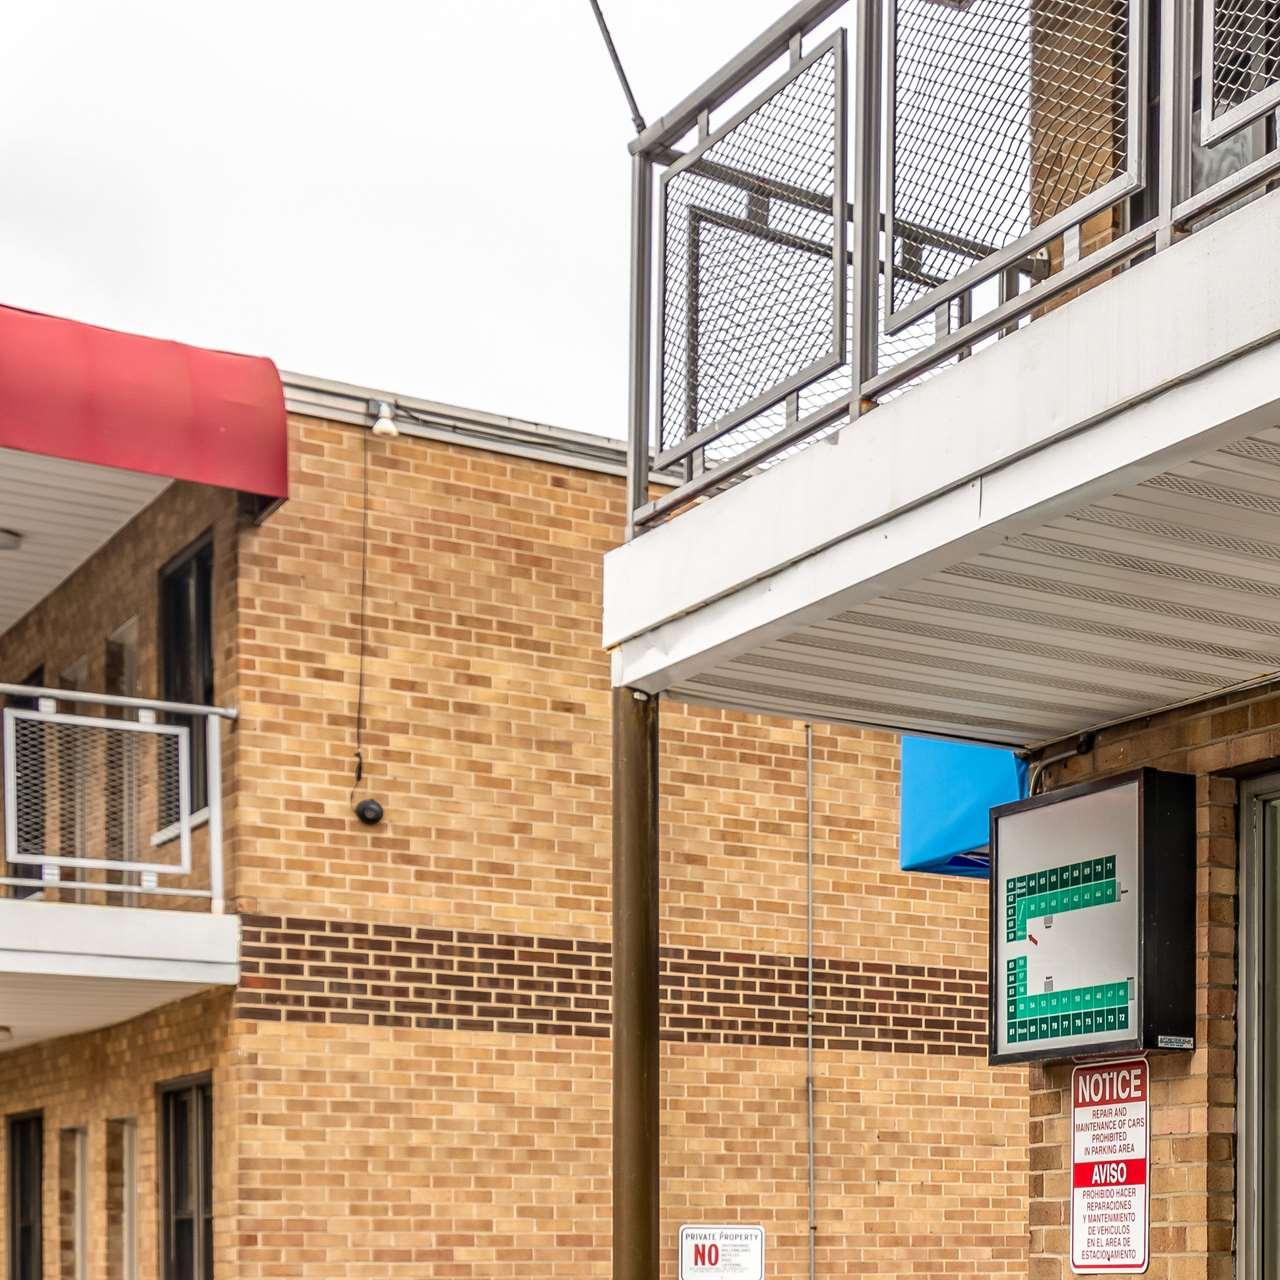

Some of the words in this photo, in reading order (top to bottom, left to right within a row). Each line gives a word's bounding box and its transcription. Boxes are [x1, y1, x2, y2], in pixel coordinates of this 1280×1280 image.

[1078, 1069, 1142, 1103] NOTICE
[1092, 1108, 1113, 1119] REPAIR
[1114, 1107, 1127, 1117] AND
[1076, 1120, 1116, 1133] MAINTENANCE
[1118, 1120, 1125, 1129] OF
[1127, 1118, 1144, 1128] CARS
[1092, 1131, 1127, 1143] PROHIBITED
[1084, 1147, 1090, 1155] IN
[1091, 1144, 1117, 1155] PARKING
[1118, 1143, 1135, 1153] AREA
[1092, 1162, 1127, 1184] AVISO
[1082, 1189, 1114, 1199] PROHIBIDO
[1116, 1188, 1136, 1198] HACER
[1086, 1200, 1132, 1211] REPARACIONES
[1083, 1215, 1086, 1223] Y
[1088, 1213, 1136, 1223] MANTENIMIENTO
[1088, 1226, 1095, 1235] DE
[1097, 1225, 1130, 1235] VEHICULOS
[1087, 1238, 1094, 1247] EN
[1097, 1238, 1103, 1247] EL
[1105, 1238, 1121, 1247] AREA
[1123, 1238, 1130, 1246] DE
[694, 1244, 719, 1266] NO
[1081, 1249, 1136, 1260] ESTACIONAMIENTO
